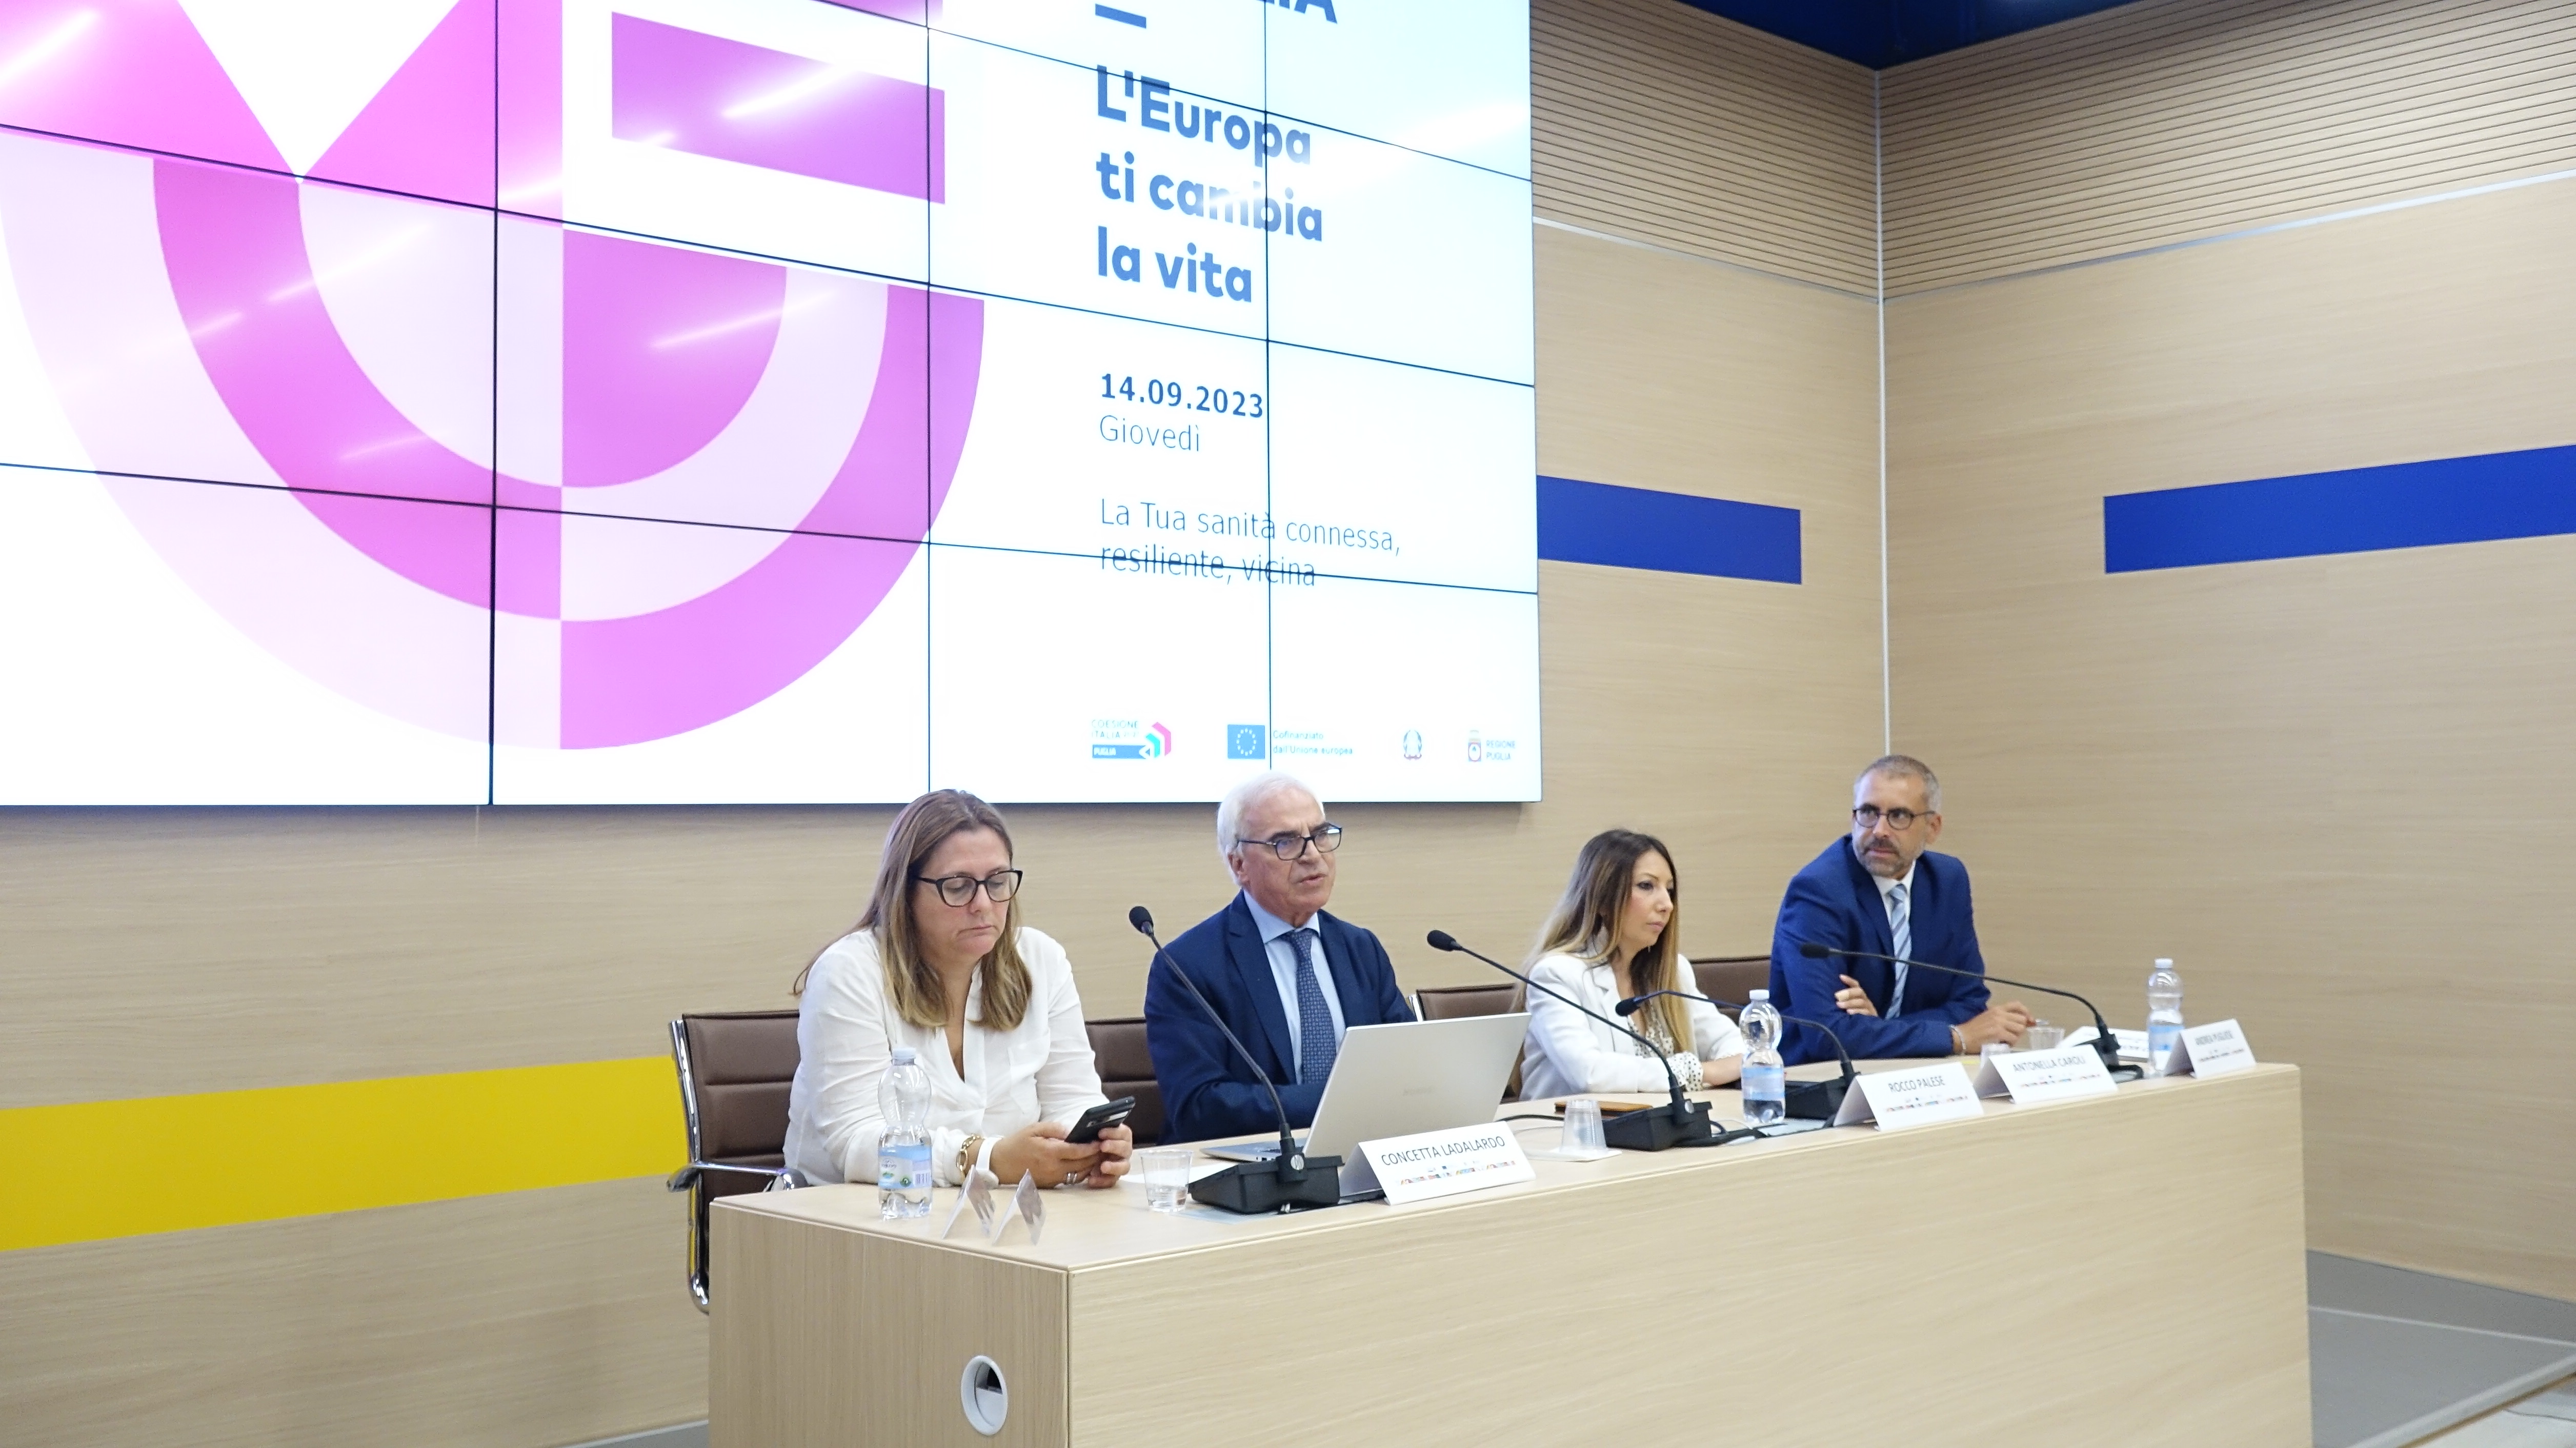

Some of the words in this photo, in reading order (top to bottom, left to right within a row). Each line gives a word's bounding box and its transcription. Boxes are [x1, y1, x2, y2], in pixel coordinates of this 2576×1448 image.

[1097, 65, 1310, 167] L'Europa
[1096, 151, 1134, 203] ti
[1149, 174, 1321, 241] cambia
[1098, 226, 1140, 283] la
[1155, 242, 1251, 302] vita
[1101, 373, 1263, 418] 14.09.2023
[1100, 415, 1199, 451] Giovedì
[1102, 498, 1129, 526] La
[1141, 501, 1185, 531] Tua
[1198, 511, 1275, 539] sanità
[1286, 521, 1400, 556] connessa,
[1102, 544, 1231, 585] resiliente,
[1242, 555, 1315, 586] vicina
[1091, 719, 1138, 729] COESIONE
[1091, 731, 1121, 739] ITALIA
[1273, 731, 1323, 739] Cofinanziato
[1321, 748, 1353, 756] europea
[1888, 1080, 1917, 1093] ROCCO
[1917, 1076, 1945, 1088] PALESE
[1381, 1147, 1441, 1165] CONCETTA
[1441, 1136, 1505, 1156] LADALARDO
